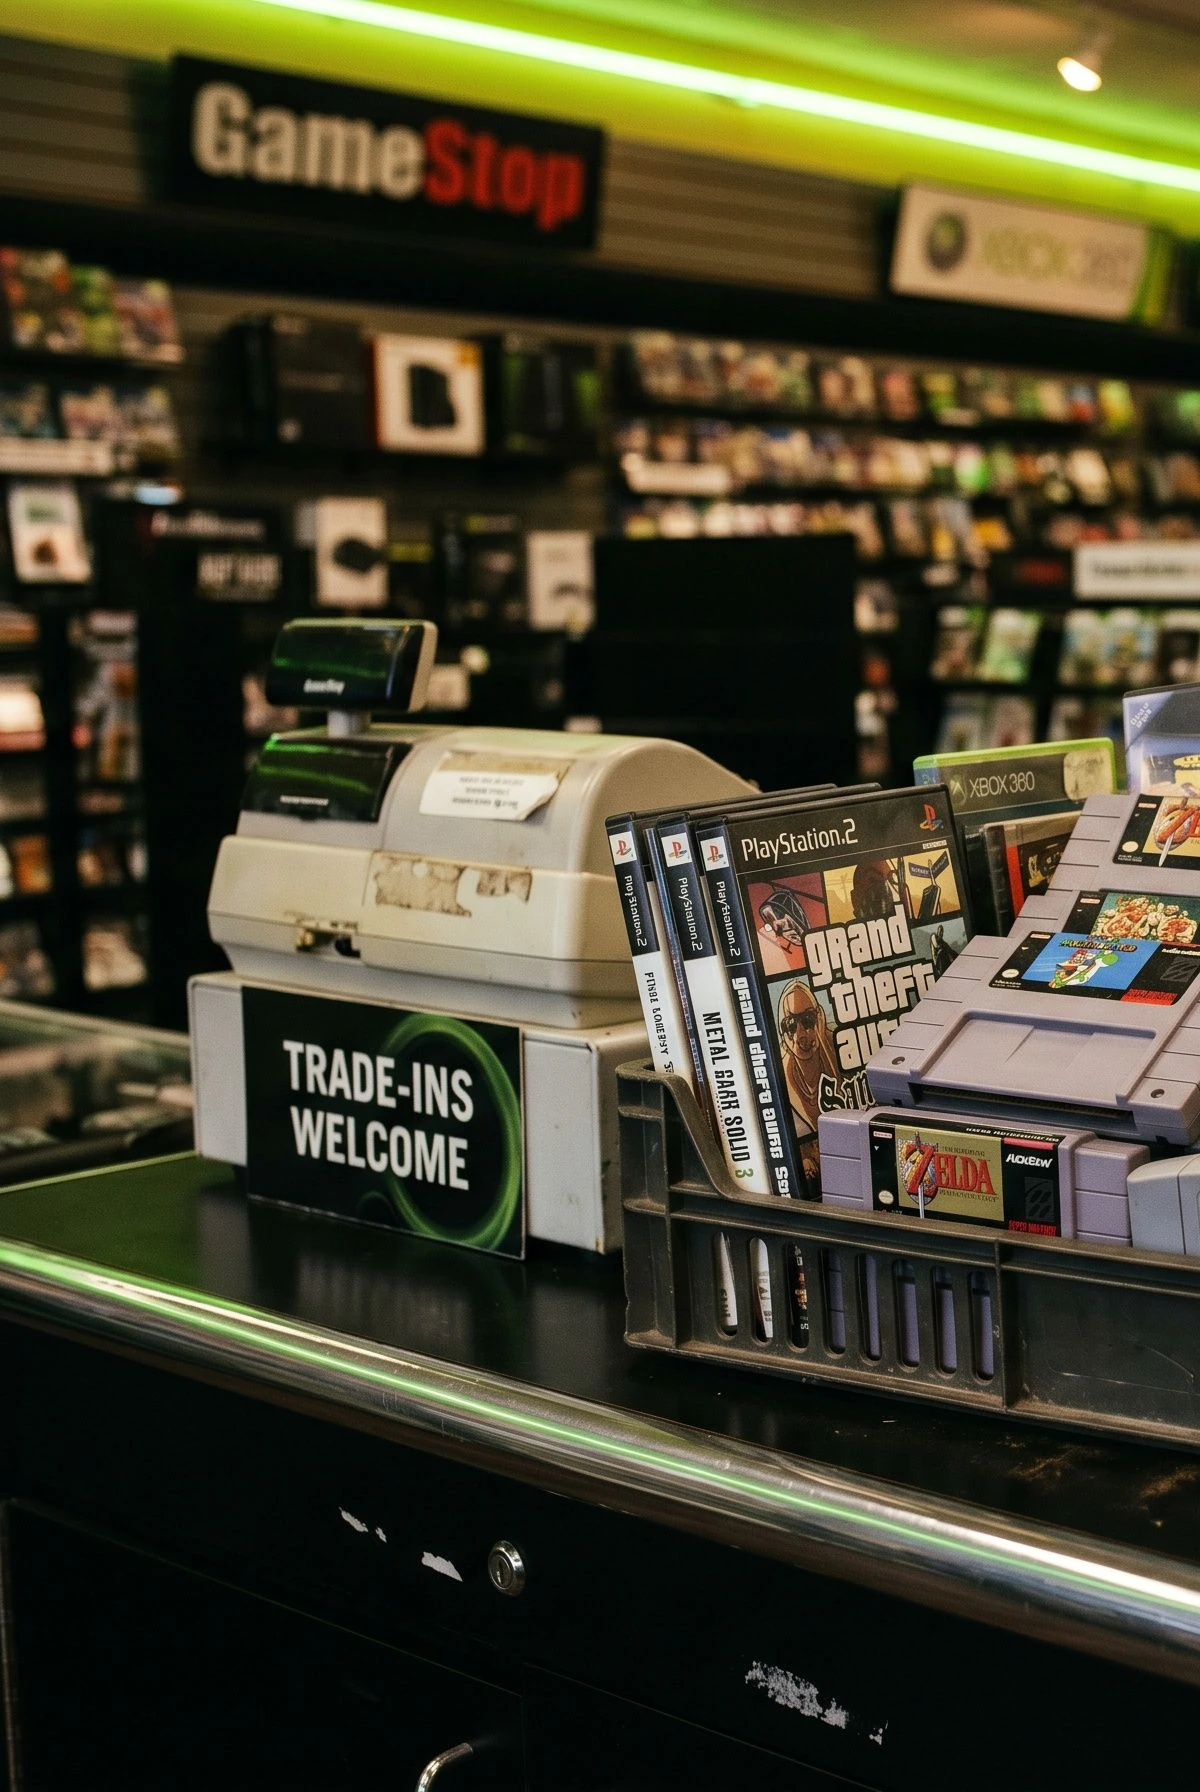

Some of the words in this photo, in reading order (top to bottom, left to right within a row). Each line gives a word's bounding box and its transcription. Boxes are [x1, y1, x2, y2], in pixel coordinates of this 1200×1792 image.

[191, 82, 585, 232] GameStop
[969, 774, 1009, 798] XBOX
[282, 1040, 474, 1122] TRADE-INS
[702, 1011, 730, 1066] METAL
[735, 1168, 754, 1179] 3
[290, 1106, 470, 1190] WELCOME
[905, 1142, 998, 1198] ZELDA
